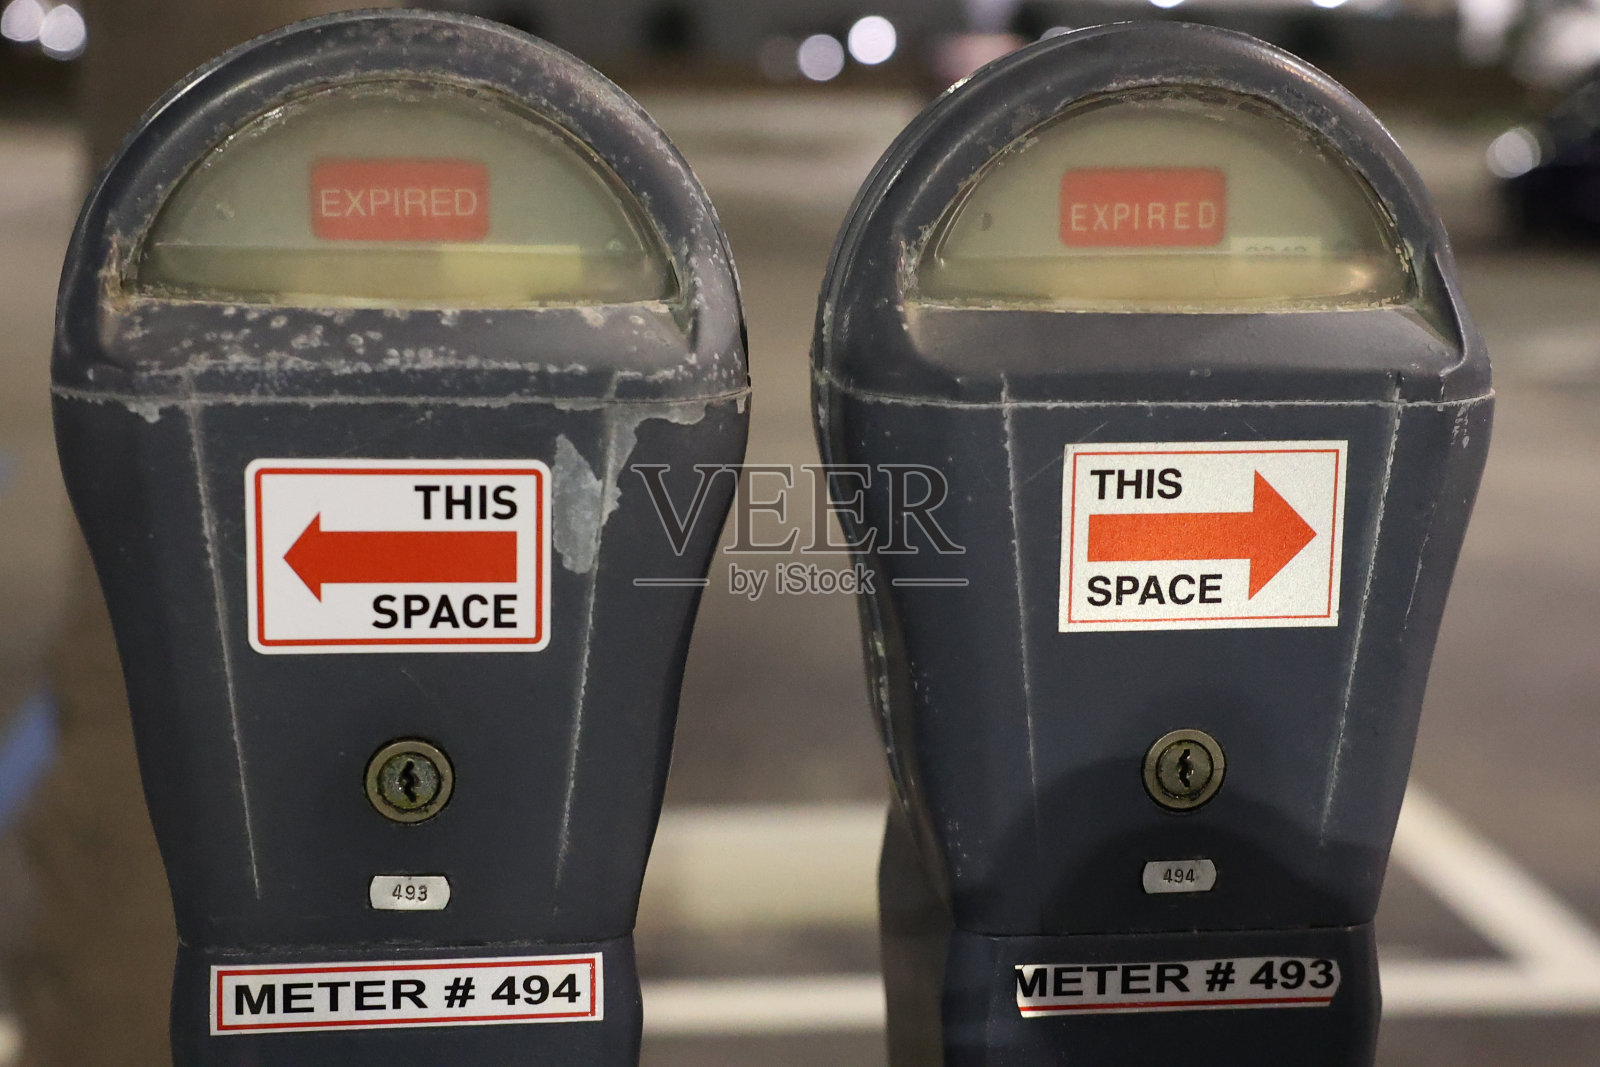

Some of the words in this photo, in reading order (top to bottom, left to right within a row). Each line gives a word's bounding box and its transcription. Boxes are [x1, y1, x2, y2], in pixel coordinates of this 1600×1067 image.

[320, 188, 477, 217] EXPIRED
[1071, 202, 1216, 231] EXPIRED
[1090, 468, 1183, 500] THIS
[414, 485, 518, 520] THIS
[1087, 574, 1222, 606] SPACE
[372, 594, 518, 629] SPACE
[1163, 868, 1195, 883] 494
[392, 884, 427, 901] 493
[234, 979, 428, 1015] METER
[444, 977, 475, 1008] #
[491, 973, 581, 1005] 494
[1016, 964, 1190, 997] METER
[1205, 961, 1235, 991] #
[1250, 959, 1335, 989] 493
